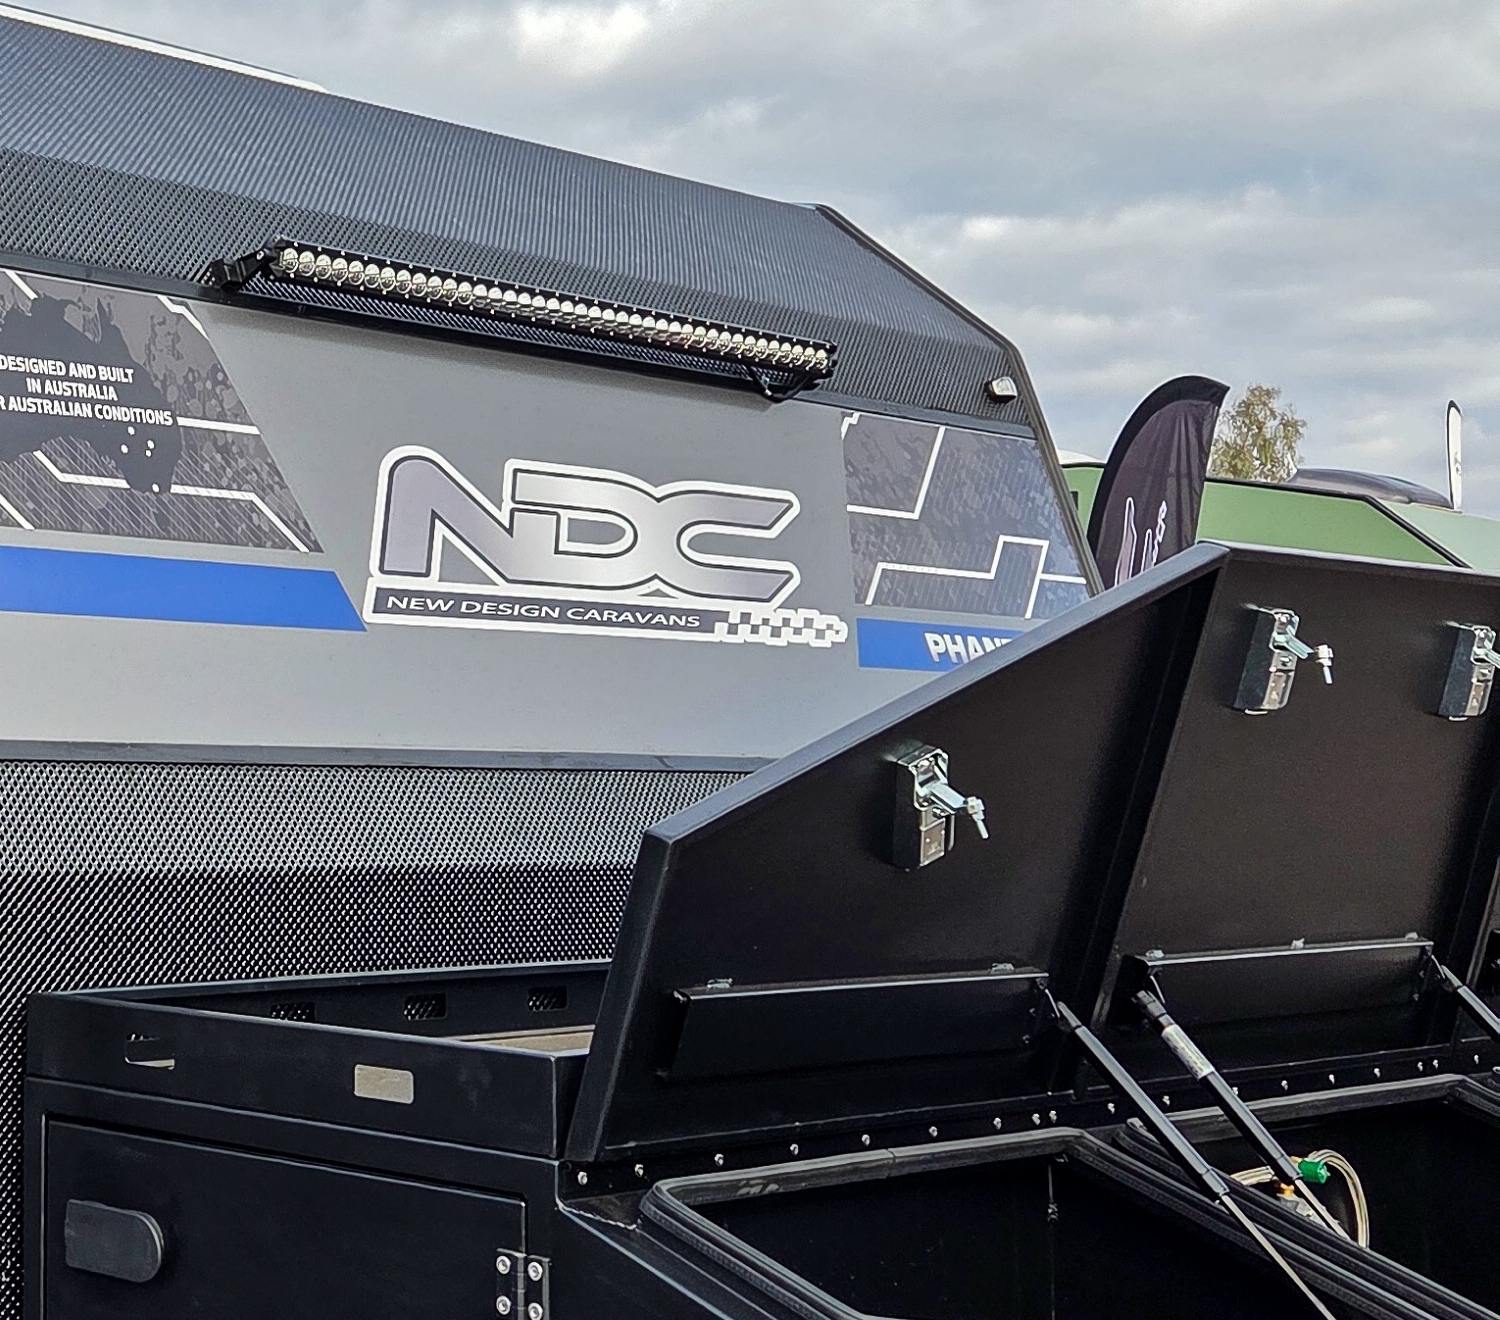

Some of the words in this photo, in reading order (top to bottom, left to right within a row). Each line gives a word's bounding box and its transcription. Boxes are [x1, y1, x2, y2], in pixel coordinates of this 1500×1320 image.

[68, 362, 97, 380] AND
[98, 365, 134, 384] BUILT
[26, 377, 41, 394] IN
[44, 380, 118, 401] AUSTRALIA
[8, 396, 93, 419] AUSTRALIAN
[94, 404, 174, 426] CONDITIONS
[379, 454, 796, 603] NDC
[386, 595, 455, 612] NEW
[460, 601, 561, 619] DESIGN
[565, 607, 701, 628] CARAVANS
